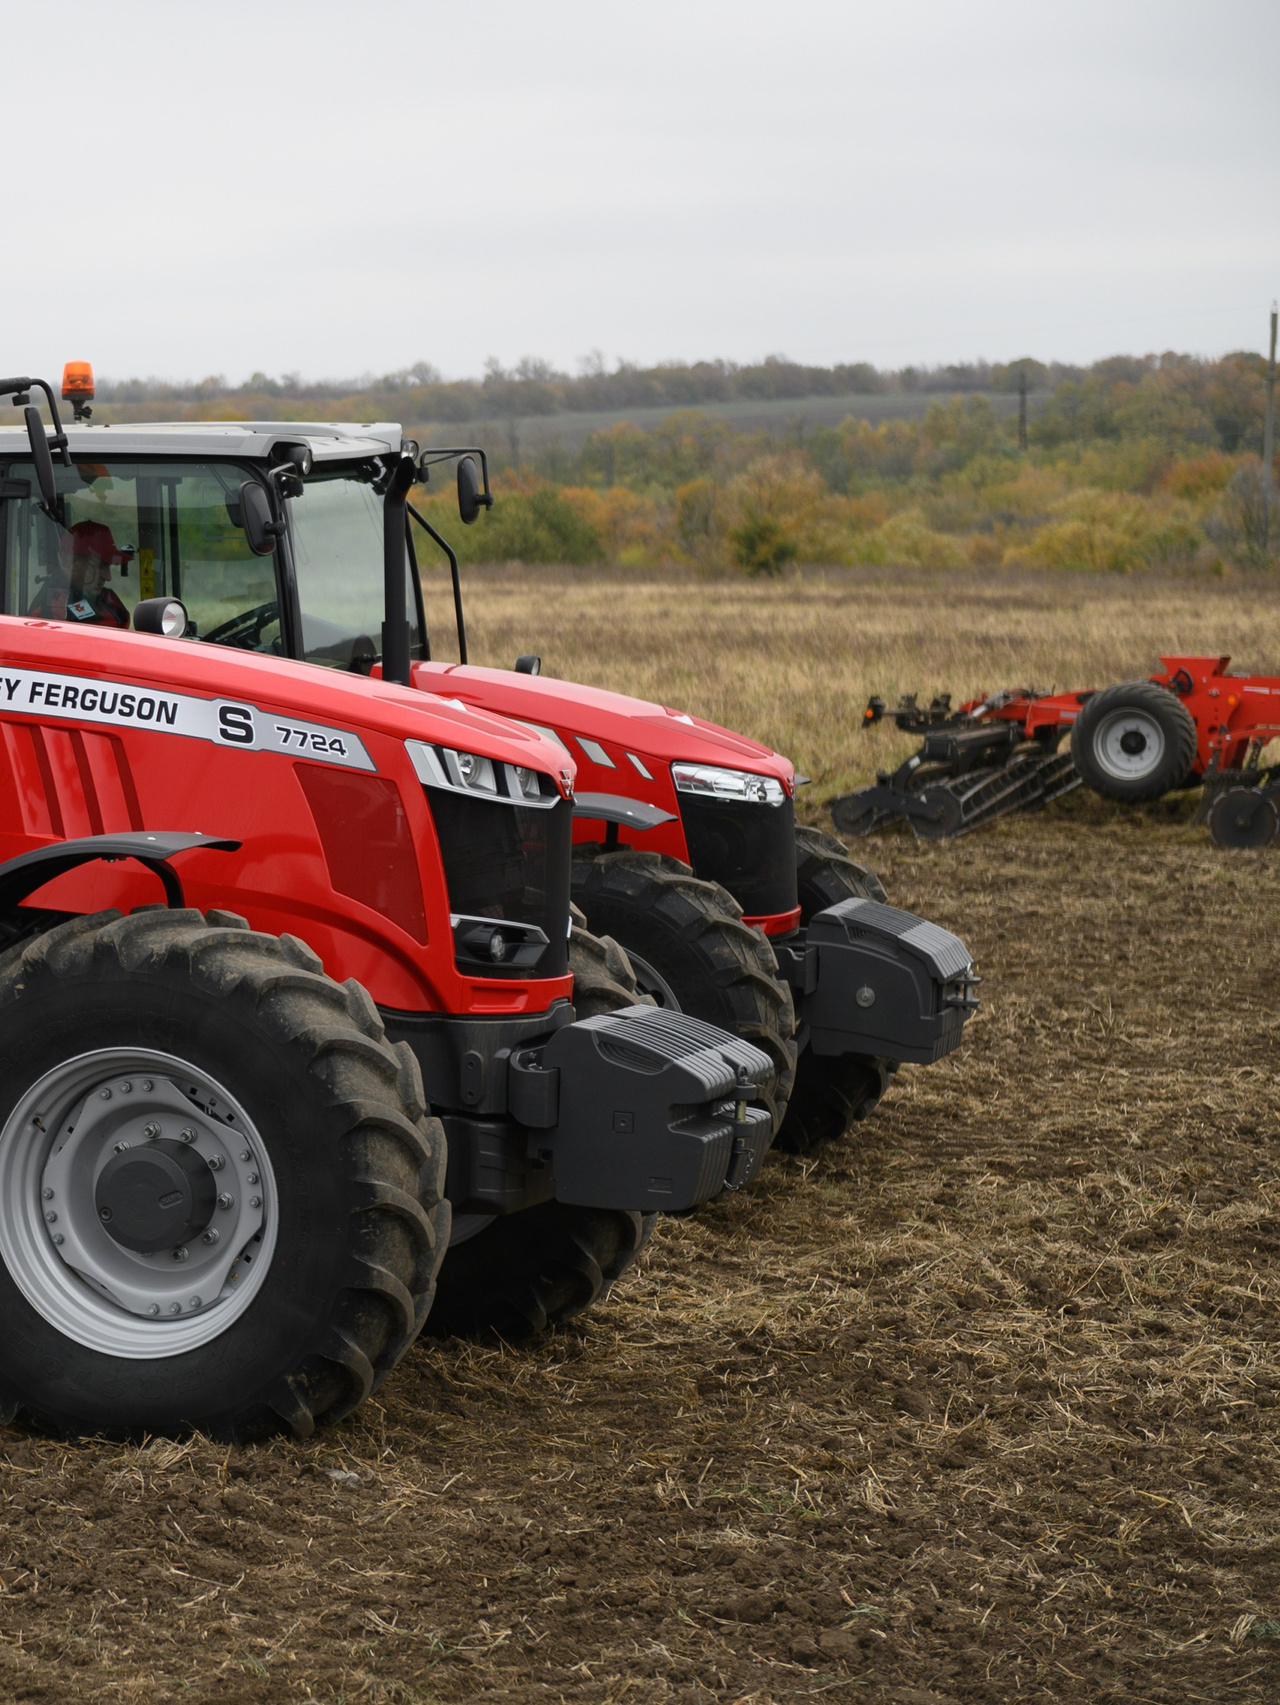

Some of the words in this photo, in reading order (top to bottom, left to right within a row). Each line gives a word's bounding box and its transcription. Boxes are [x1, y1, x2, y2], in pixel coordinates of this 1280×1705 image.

[29, 681, 179, 725] FERGUSON
[218, 705, 255, 744] S
[275, 725, 347, 756] 7724
